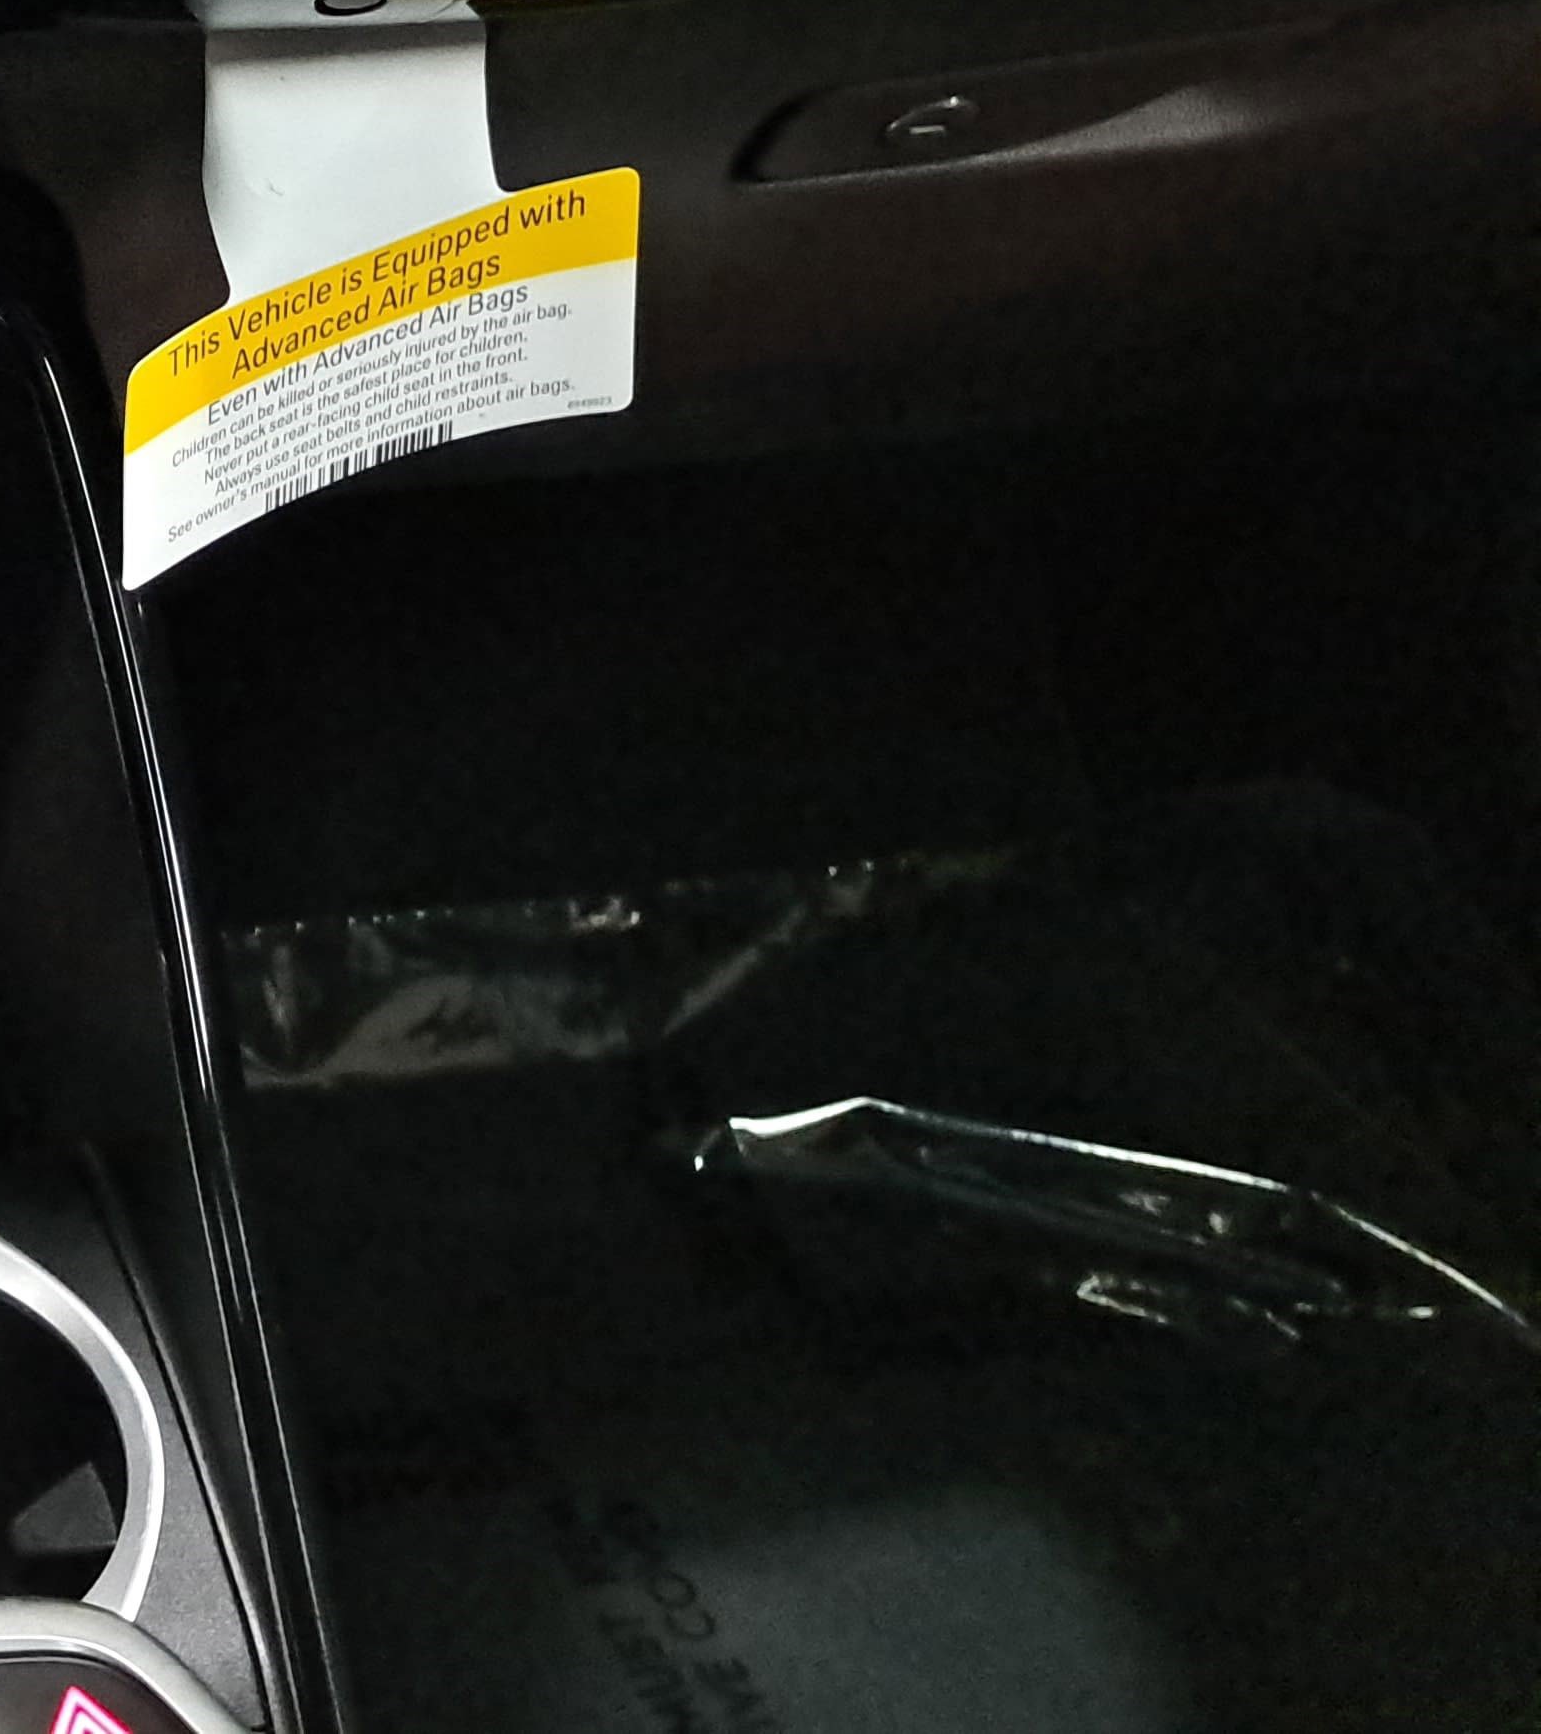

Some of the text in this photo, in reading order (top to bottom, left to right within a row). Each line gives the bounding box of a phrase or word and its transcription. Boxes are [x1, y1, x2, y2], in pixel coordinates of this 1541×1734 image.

[168, 189, 585, 377] This Vehicle is Equipped with
[207, 285, 528, 426] Even with Advanced Air Bags
[231, 254, 500, 379] Advanced Air Bags
[172, 302, 571, 468] Children can be killed or seriously injured by the air bag.
